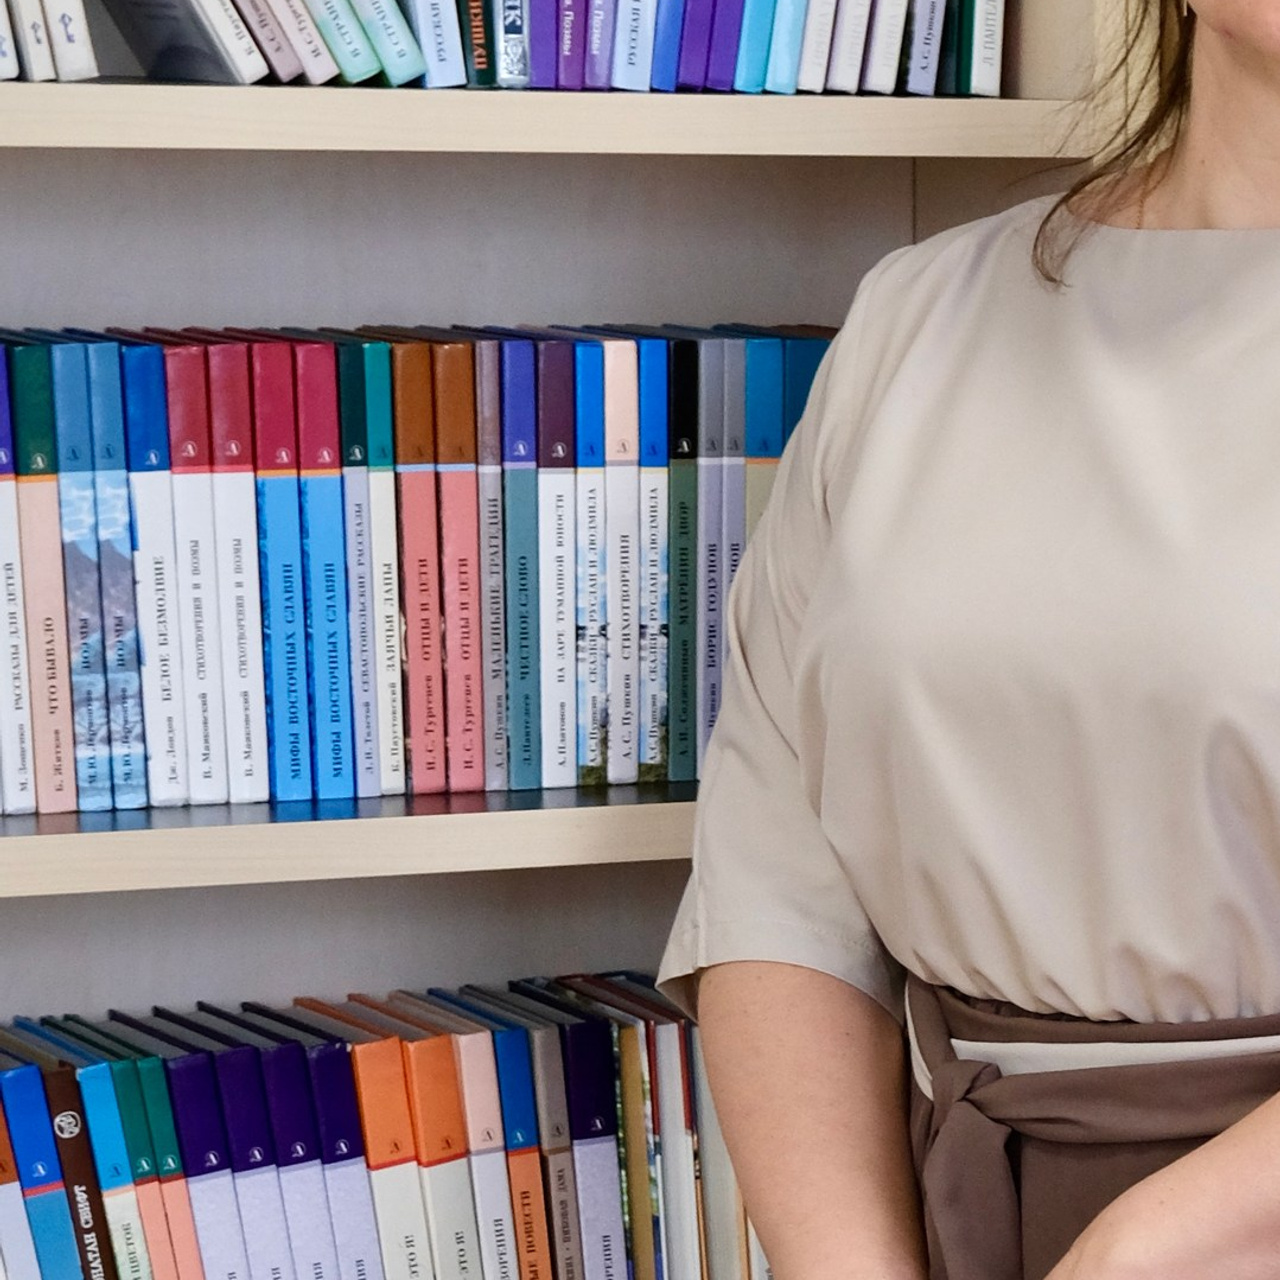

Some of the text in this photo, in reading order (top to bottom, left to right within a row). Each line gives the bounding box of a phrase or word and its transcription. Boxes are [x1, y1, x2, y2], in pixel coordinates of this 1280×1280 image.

[469, 0, 487, 70] ПУШКИ
[562, 11, 578, 56] Поэмы
[591, 10, 606, 55] Поэмы
[353, 503, 370, 693] СЕВАСТОПОЛЬСКИЕ РАССКАЗЫ
[486, 498, 502, 680] МАЛЕНЬКИЕ ТРАГЕДИИ
[517, 556, 530, 681] ЧЕСТНОЕ СЛОВО
[554, 494, 565, 659] ЗАРЕ ТУМАННОЙ ЮНОСТИ
[587, 488, 598, 683] СКАЗКИ РУСЛАН ЛЮДМИЛА
[648, 487, 659, 621] РУСЛАН ЛЮДМИЛА
[677, 501, 689, 723] Солженицын МАТРЁНИН ДВОР
[706, 543, 718, 668] БОРИС ГОДУНОВ
[4, 562, 24, 710] РАССКАЗЫ ДЛЯ ДЕТЕЙ
[44, 617, 59, 715] ЧТО БЫВАЛО
[79, 618, 91, 669] ПОЭМЫ
[114, 616, 126, 667] ПОЭМЫ
[153, 556, 176, 758] Лондон БЕЛОЕ БЕЗМОЛВИЕ
[189, 540, 212, 762] Маяковский СТИХОТВОРЕНИЯ ПОЭМЫ
[232, 538, 252, 759] Маяковский СТИХОТВОРЕНИЯ ПОЭМЫ
[282, 563, 302, 780] МИФЫ ВОСТОЧНЫХ СЛАВЯН
[324, 562, 343, 778] МИФЫ ВОСТОЧНЫХ СЛАВЯН
[382, 562, 400, 756] Паустовский ЗАЯЧЬИ ЛАПЫ
[417, 559, 436, 734] Тургенев ОТЦЫ ДЕТИ
[457, 558, 475, 733] Тургенев ОТЦЫ ДЕТИ
[620, 534, 632, 726] Пушкин СТИХОТВОРЕНИЯ
[74, 1184, 94, 1227] СВИФТ
[121, 1223, 141, 1273] ЦВЕТОК
[522, 1190, 536, 1253] ПОВЕСТИ
[557, 1168, 568, 1193] ДАМА
[407, 1252, 420, 1278] ЭТО
[456, 1248, 469, 1274] ЭТО
